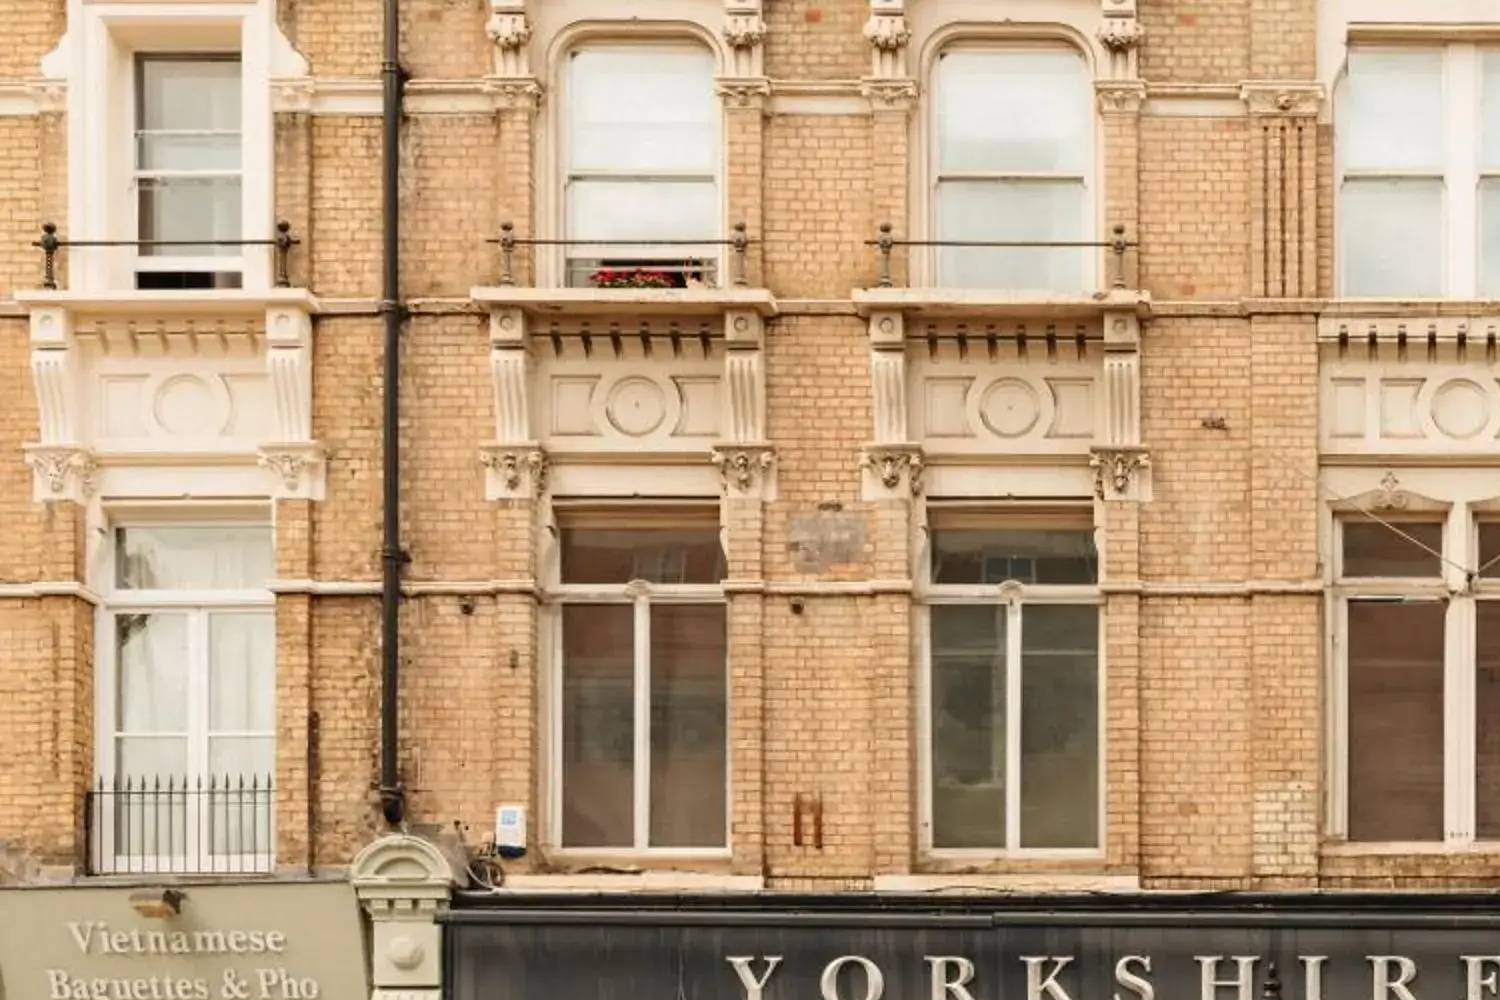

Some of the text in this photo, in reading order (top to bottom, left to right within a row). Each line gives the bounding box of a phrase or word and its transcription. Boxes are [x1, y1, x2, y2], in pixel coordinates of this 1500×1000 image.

[66, 921, 288, 953] Vietnamese
[220, 968, 252, 1000] &
[256, 968, 320, 1000] Pho
